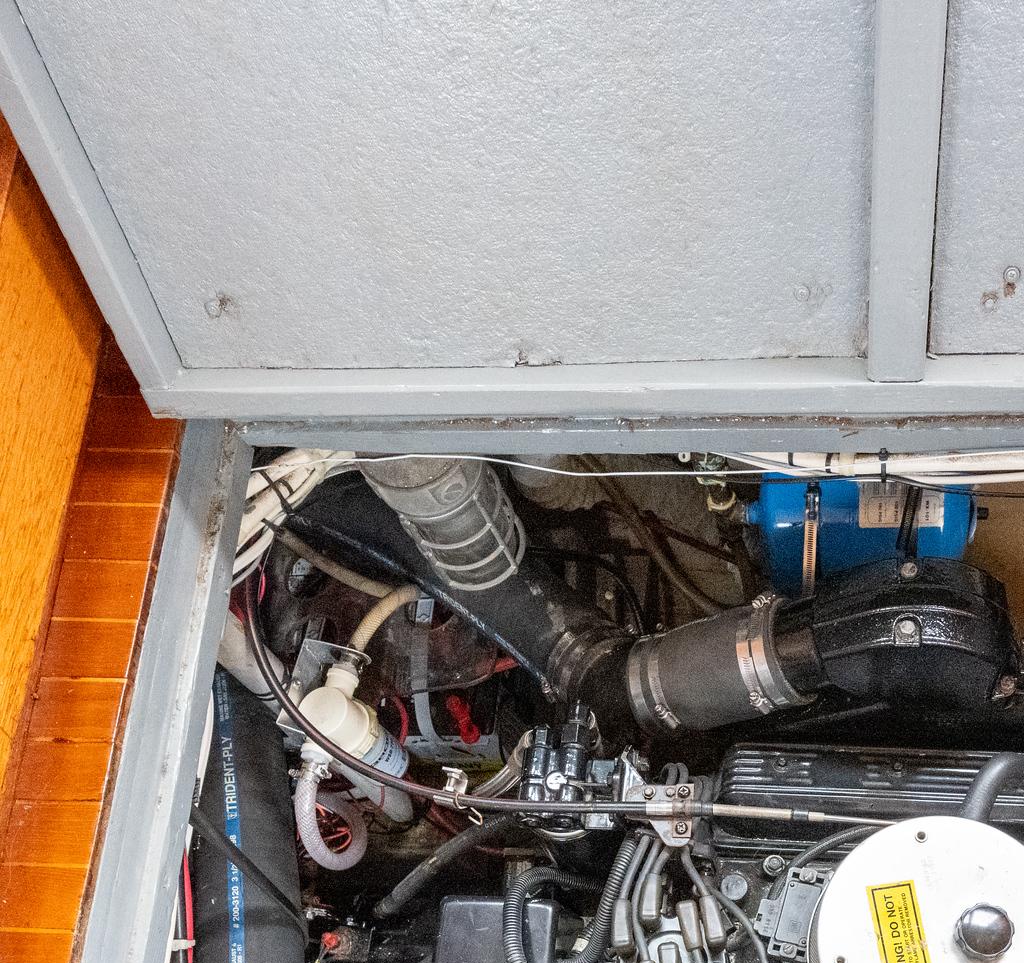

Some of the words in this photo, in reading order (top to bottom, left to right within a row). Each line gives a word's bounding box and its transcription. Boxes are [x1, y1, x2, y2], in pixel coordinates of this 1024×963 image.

[221, 735, 237, 810] TRIDENT-PLY
[231, 886, 240, 921] 200-3120
[883, 894, 897, 918] NOT
[901, 892, 911, 917] REMOVED
[898, 906, 907, 929] OPERATE
[889, 921, 901, 939] DO
[903, 930, 908, 939] OR
[907, 918, 916, 946] ARRESTOR
[908, 955, 913, 963] TO
